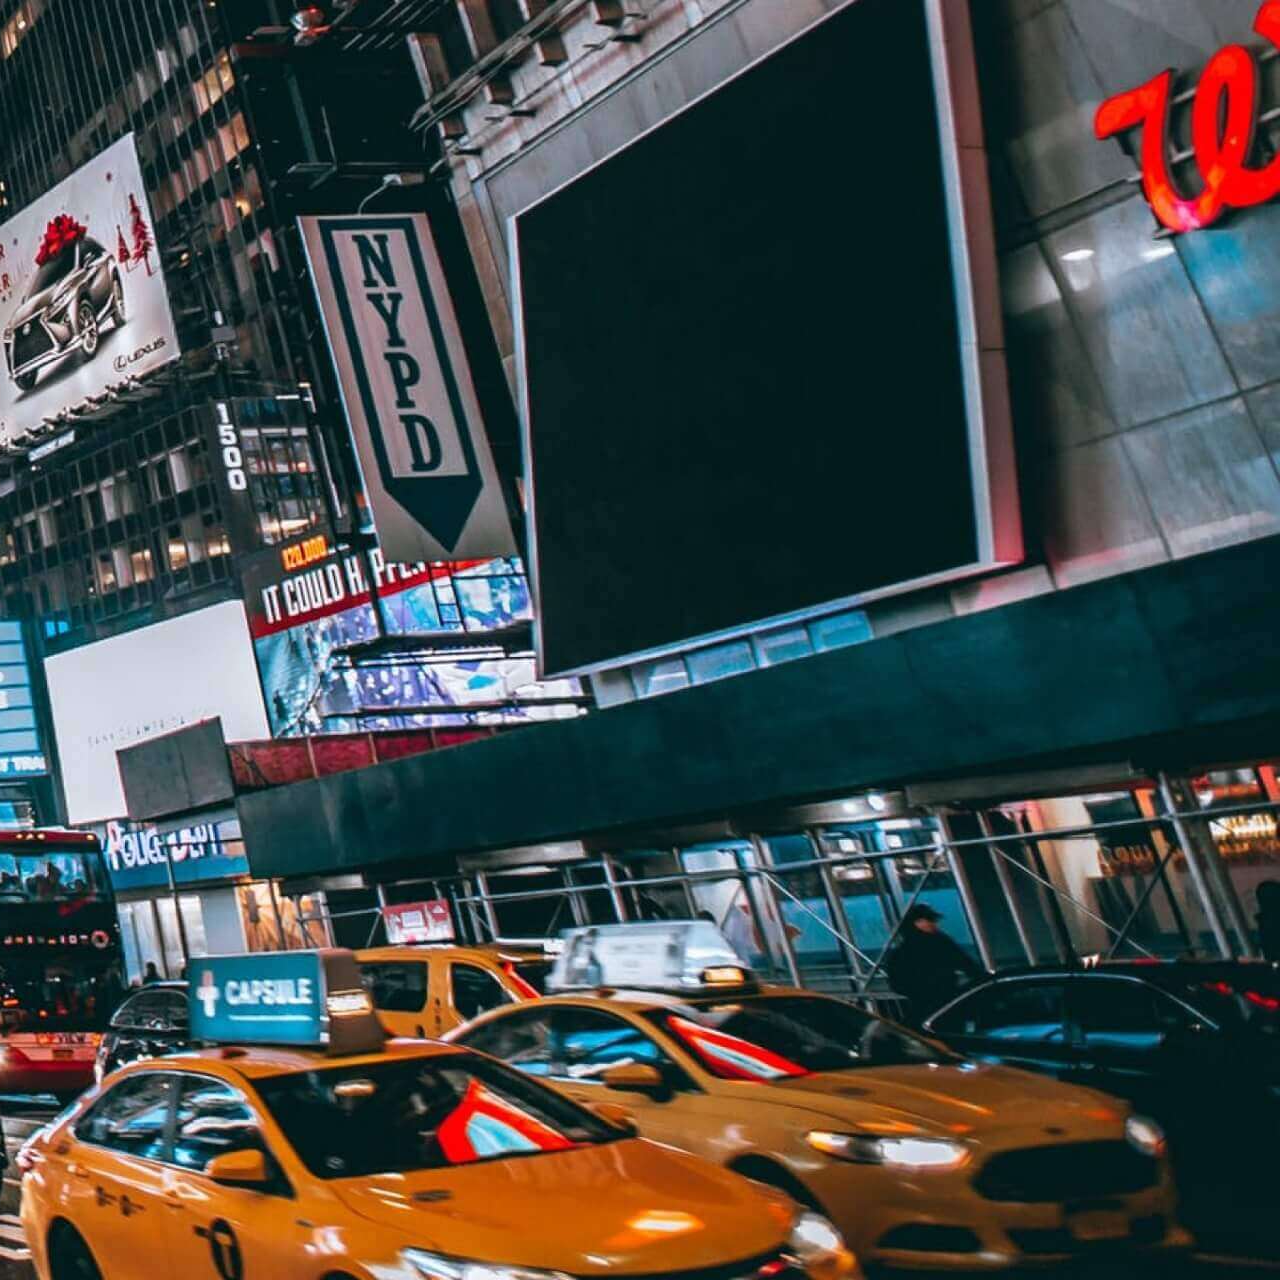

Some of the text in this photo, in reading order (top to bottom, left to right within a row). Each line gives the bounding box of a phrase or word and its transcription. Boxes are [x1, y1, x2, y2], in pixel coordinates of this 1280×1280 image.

[127, 336, 166, 363] LEXUS
[351, 232, 443, 473] NYPD
[216, 402, 248, 491] 1500
[262, 585, 282, 624] IT
[282, 563, 346, 617] COULD
[107, 820, 168, 871] POLICE
[225, 978, 313, 1006] CAPSULE
